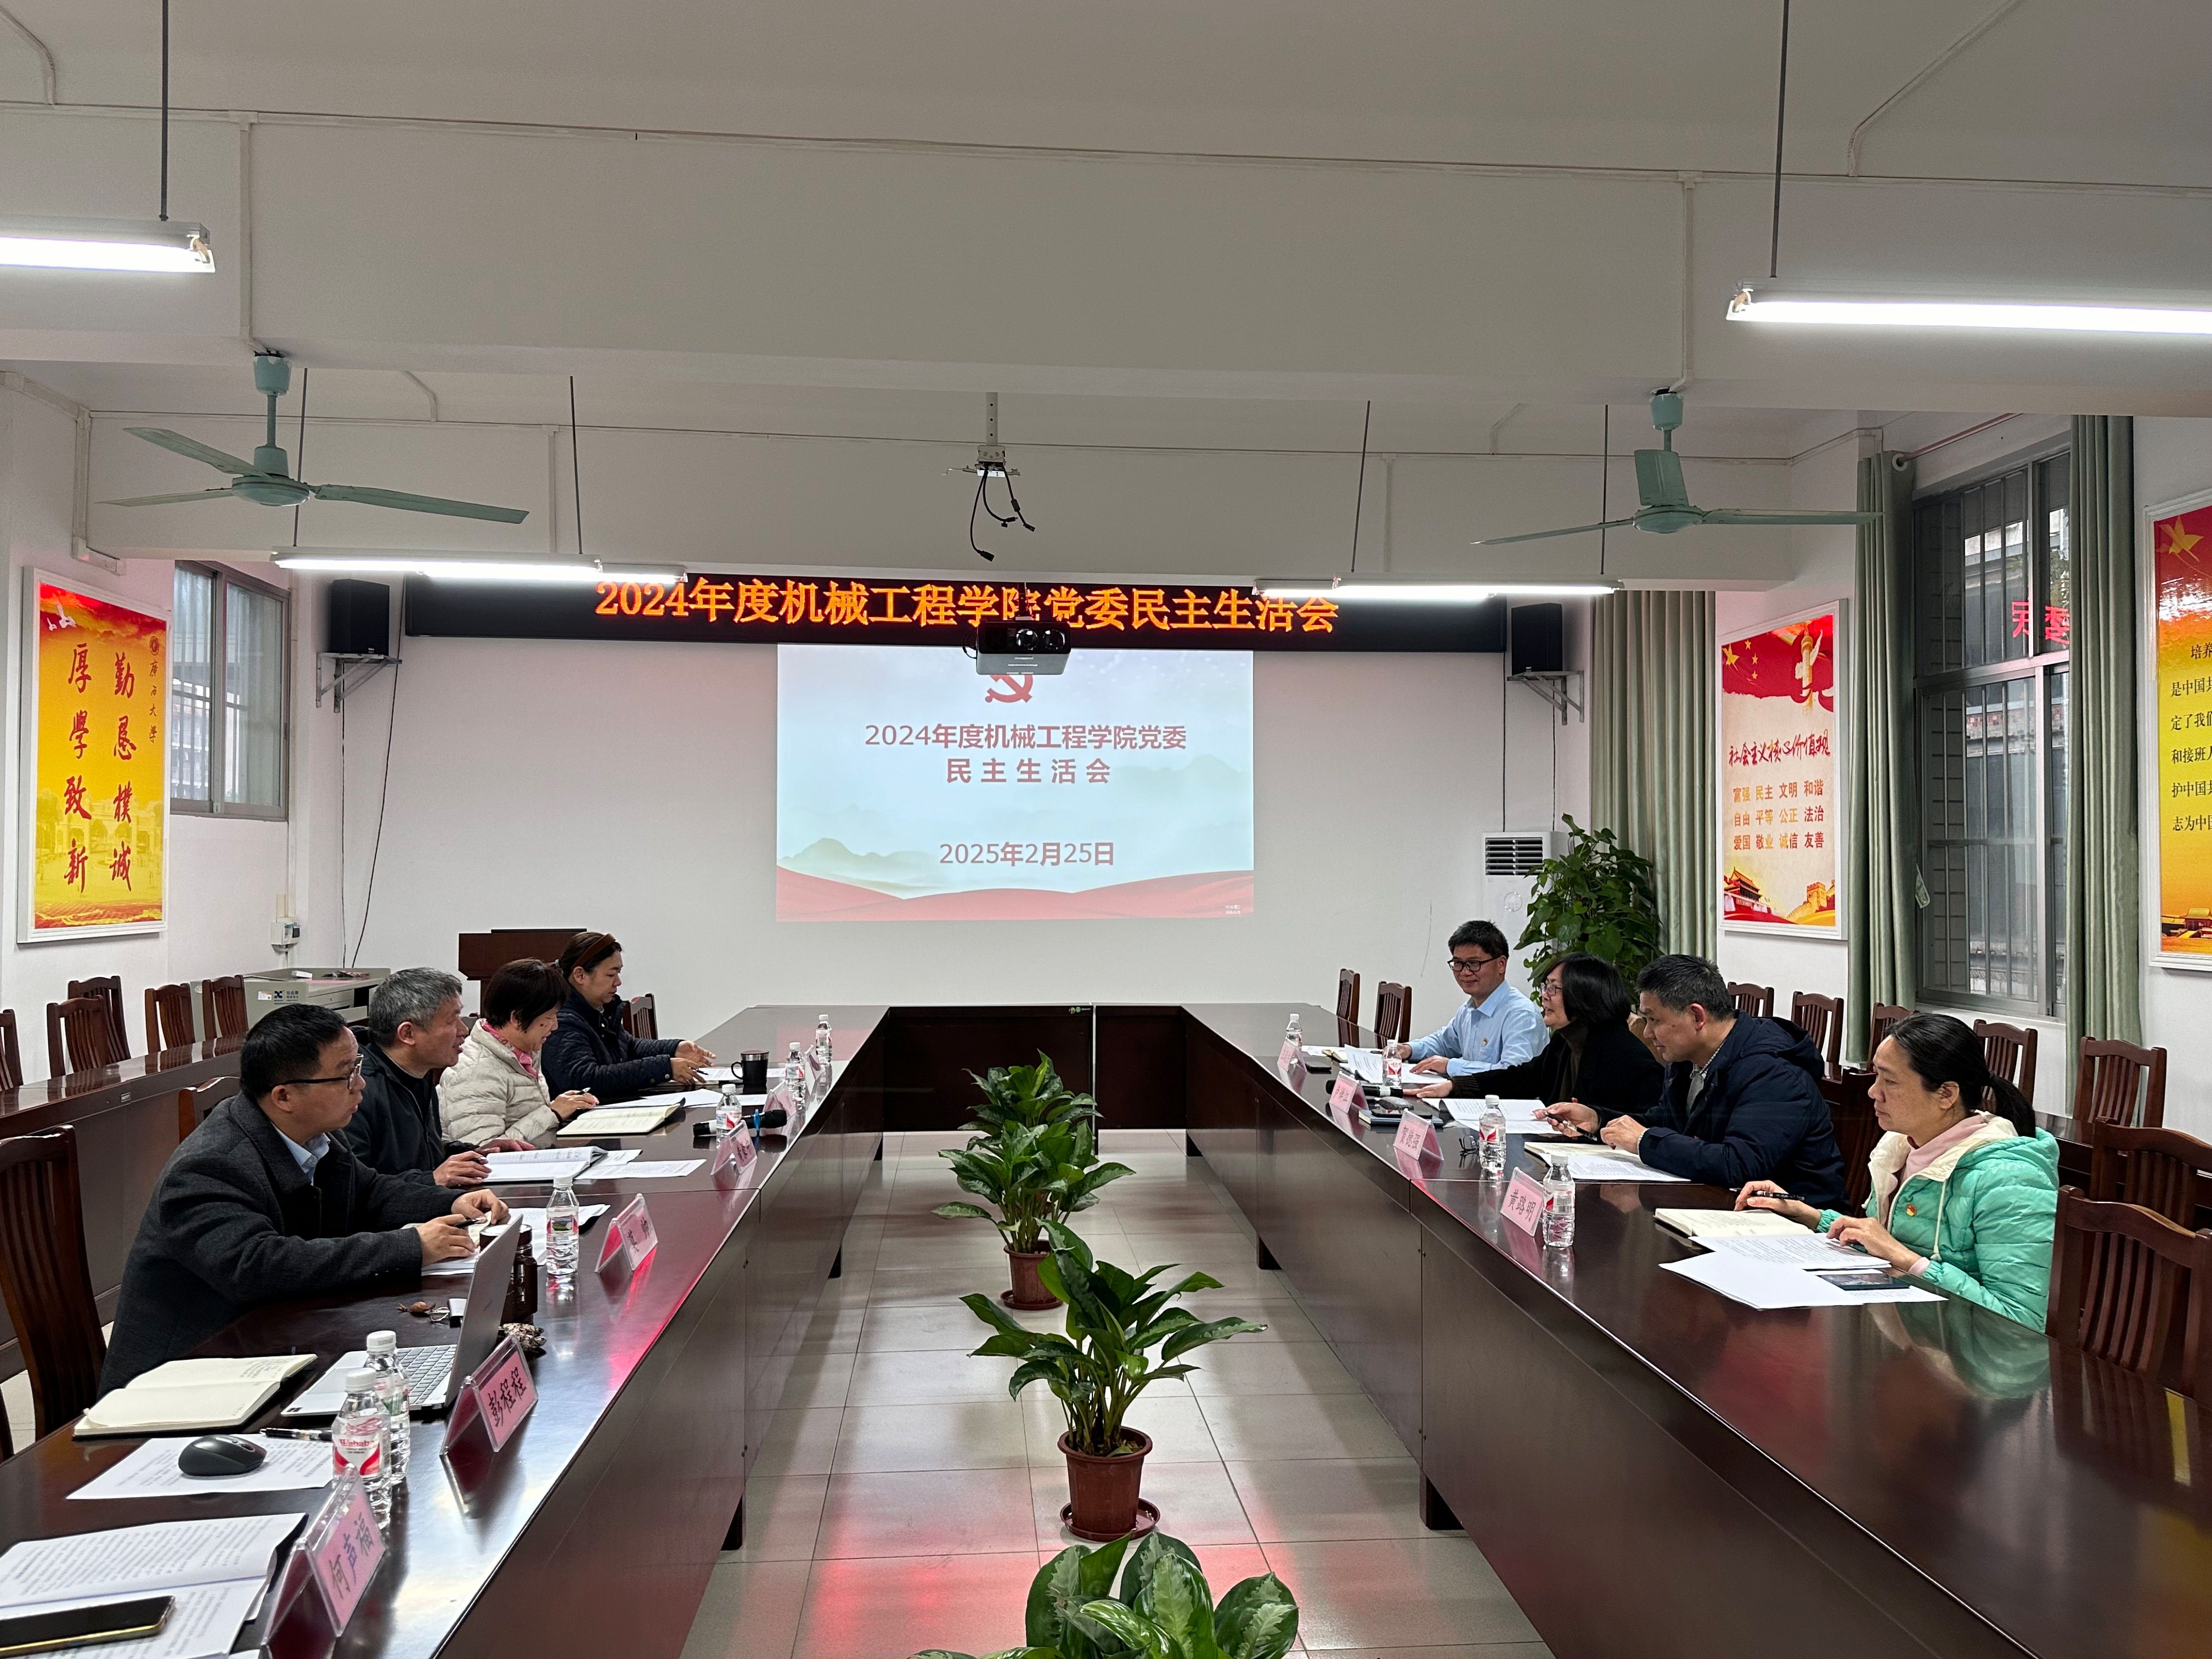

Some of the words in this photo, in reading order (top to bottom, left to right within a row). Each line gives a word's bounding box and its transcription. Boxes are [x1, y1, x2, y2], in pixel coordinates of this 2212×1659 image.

[595, 577, 1339, 633] 2024年度机械工程学院党委民主生活会
[865, 723, 1187, 750] 2024年度机械工程学院党委
[1729, 729, 1831, 767] 社会主义核心价值观
[946, 758, 1110, 783] 民主生活会
[1733, 787, 1751, 803] 富强
[1756, 785, 1773, 800] 民主
[1779, 782, 1797, 798] 文明
[1804, 779, 1824, 796] 和谐
[1734, 811, 1750, 827] 自由
[1756, 809, 1773, 825] 平等
[1779, 808, 1798, 823] 公正
[1804, 805, 1824, 822] 法治
[1734, 834, 1751, 850] 爱国
[1756, 834, 1773, 850] 敬业
[1779, 832, 1798, 849] 诚信
[1804, 831, 1824, 848] 友善
[940, 842, 1114, 866] 2025年2月25日
[1508, 1189, 1536, 1222] 黄路明
[488, 1367, 527, 1427] 彭程程
